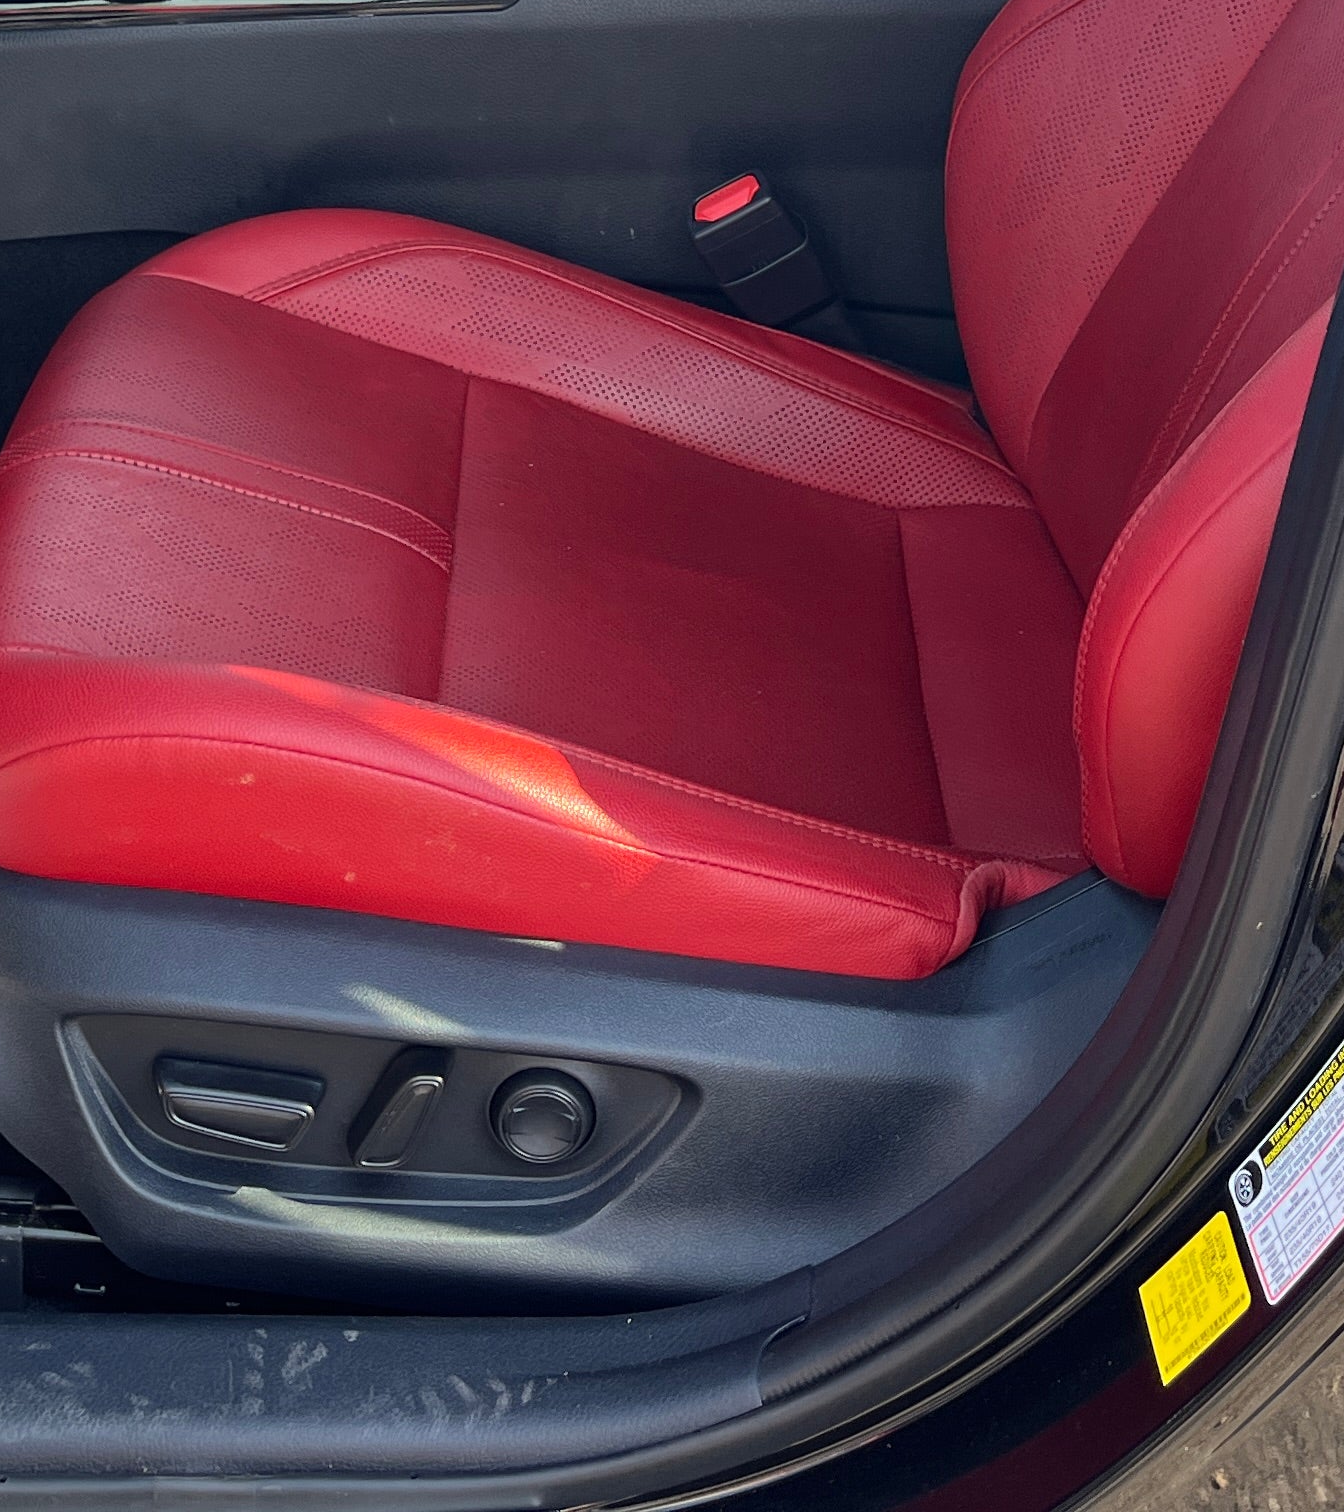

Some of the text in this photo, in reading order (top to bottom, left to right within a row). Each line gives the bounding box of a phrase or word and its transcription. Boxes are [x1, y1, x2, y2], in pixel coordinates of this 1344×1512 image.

[1268, 1120, 1288, 1148] TIRE
[1286, 1099, 1305, 1126] AND
[1304, 1058, 1338, 1105] LOADING
